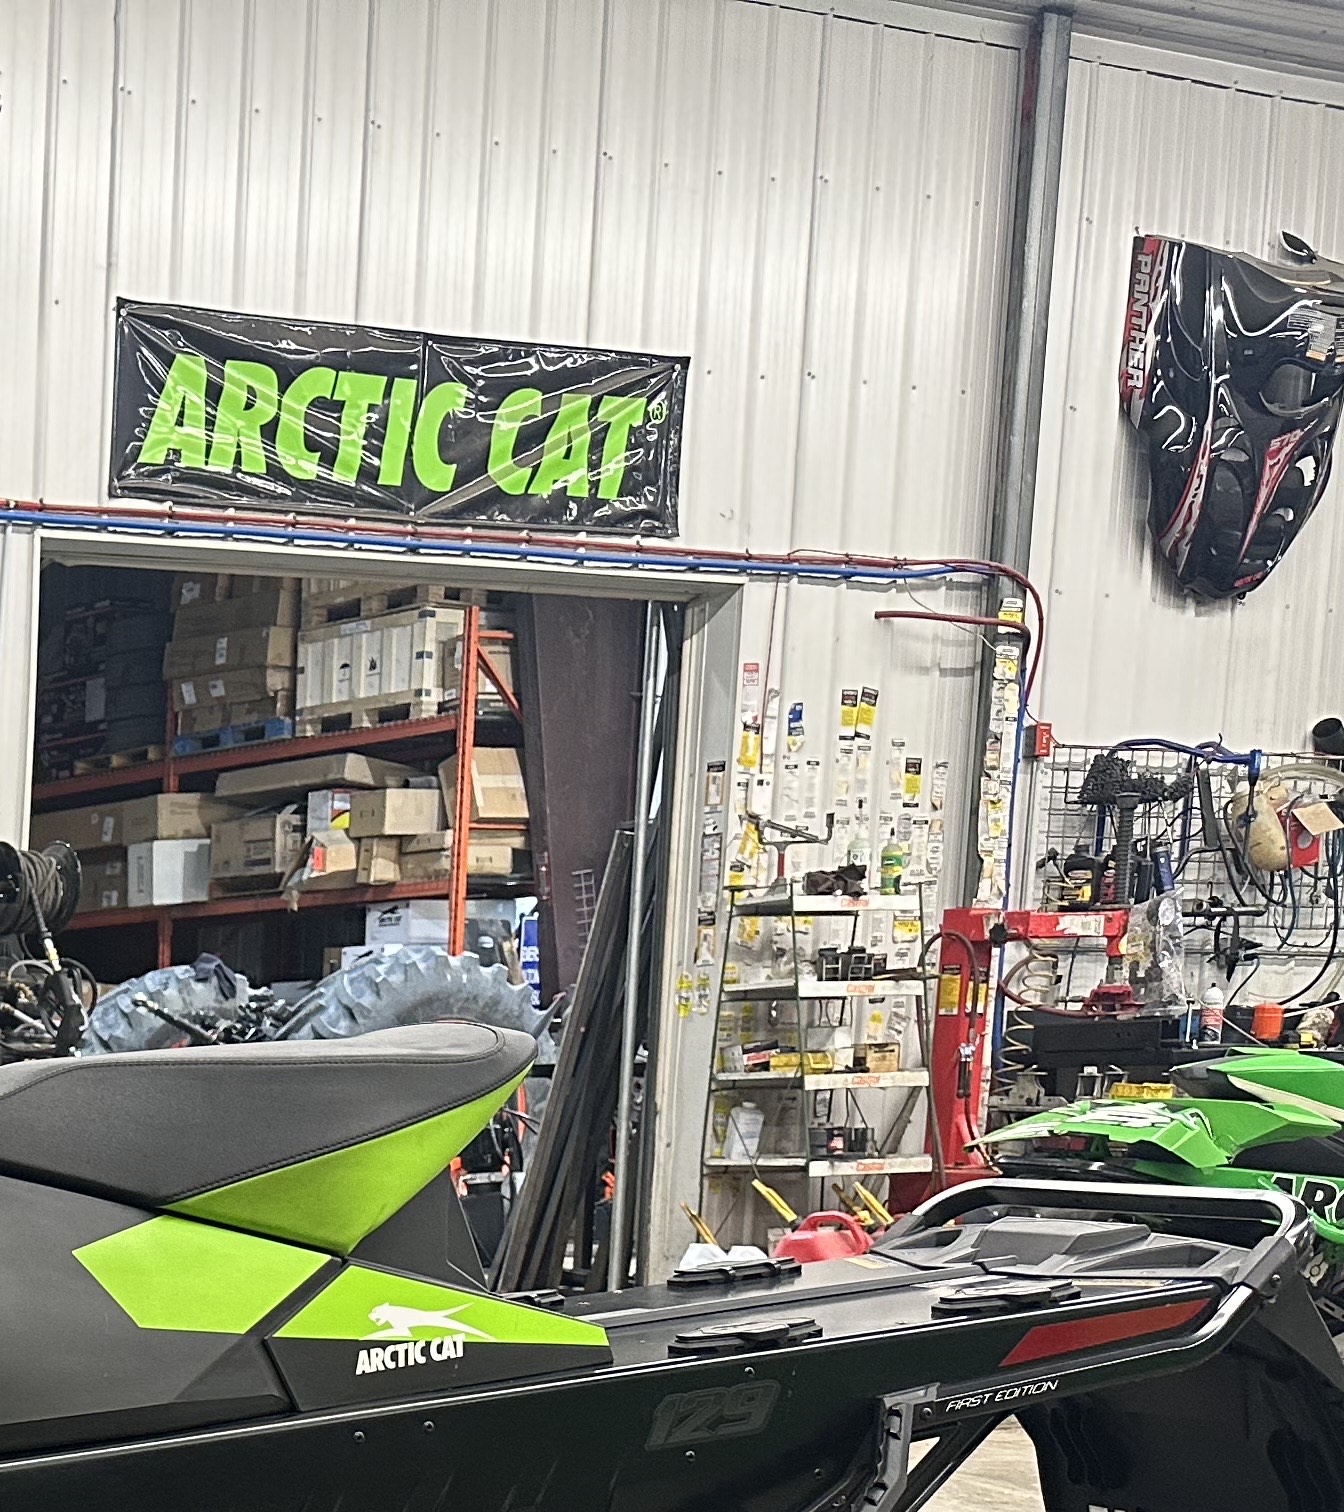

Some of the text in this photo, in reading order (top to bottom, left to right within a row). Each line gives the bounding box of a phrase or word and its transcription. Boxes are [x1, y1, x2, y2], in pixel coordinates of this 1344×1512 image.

[1126, 254, 1152, 389] PANTHER
[137, 353, 467, 493] ARCTIC
[355, 1334, 466, 1375] ARCTIC CAT
[645, 1380, 781, 1452] 129
[945, 1380, 1060, 1413] FIRST EDITION
